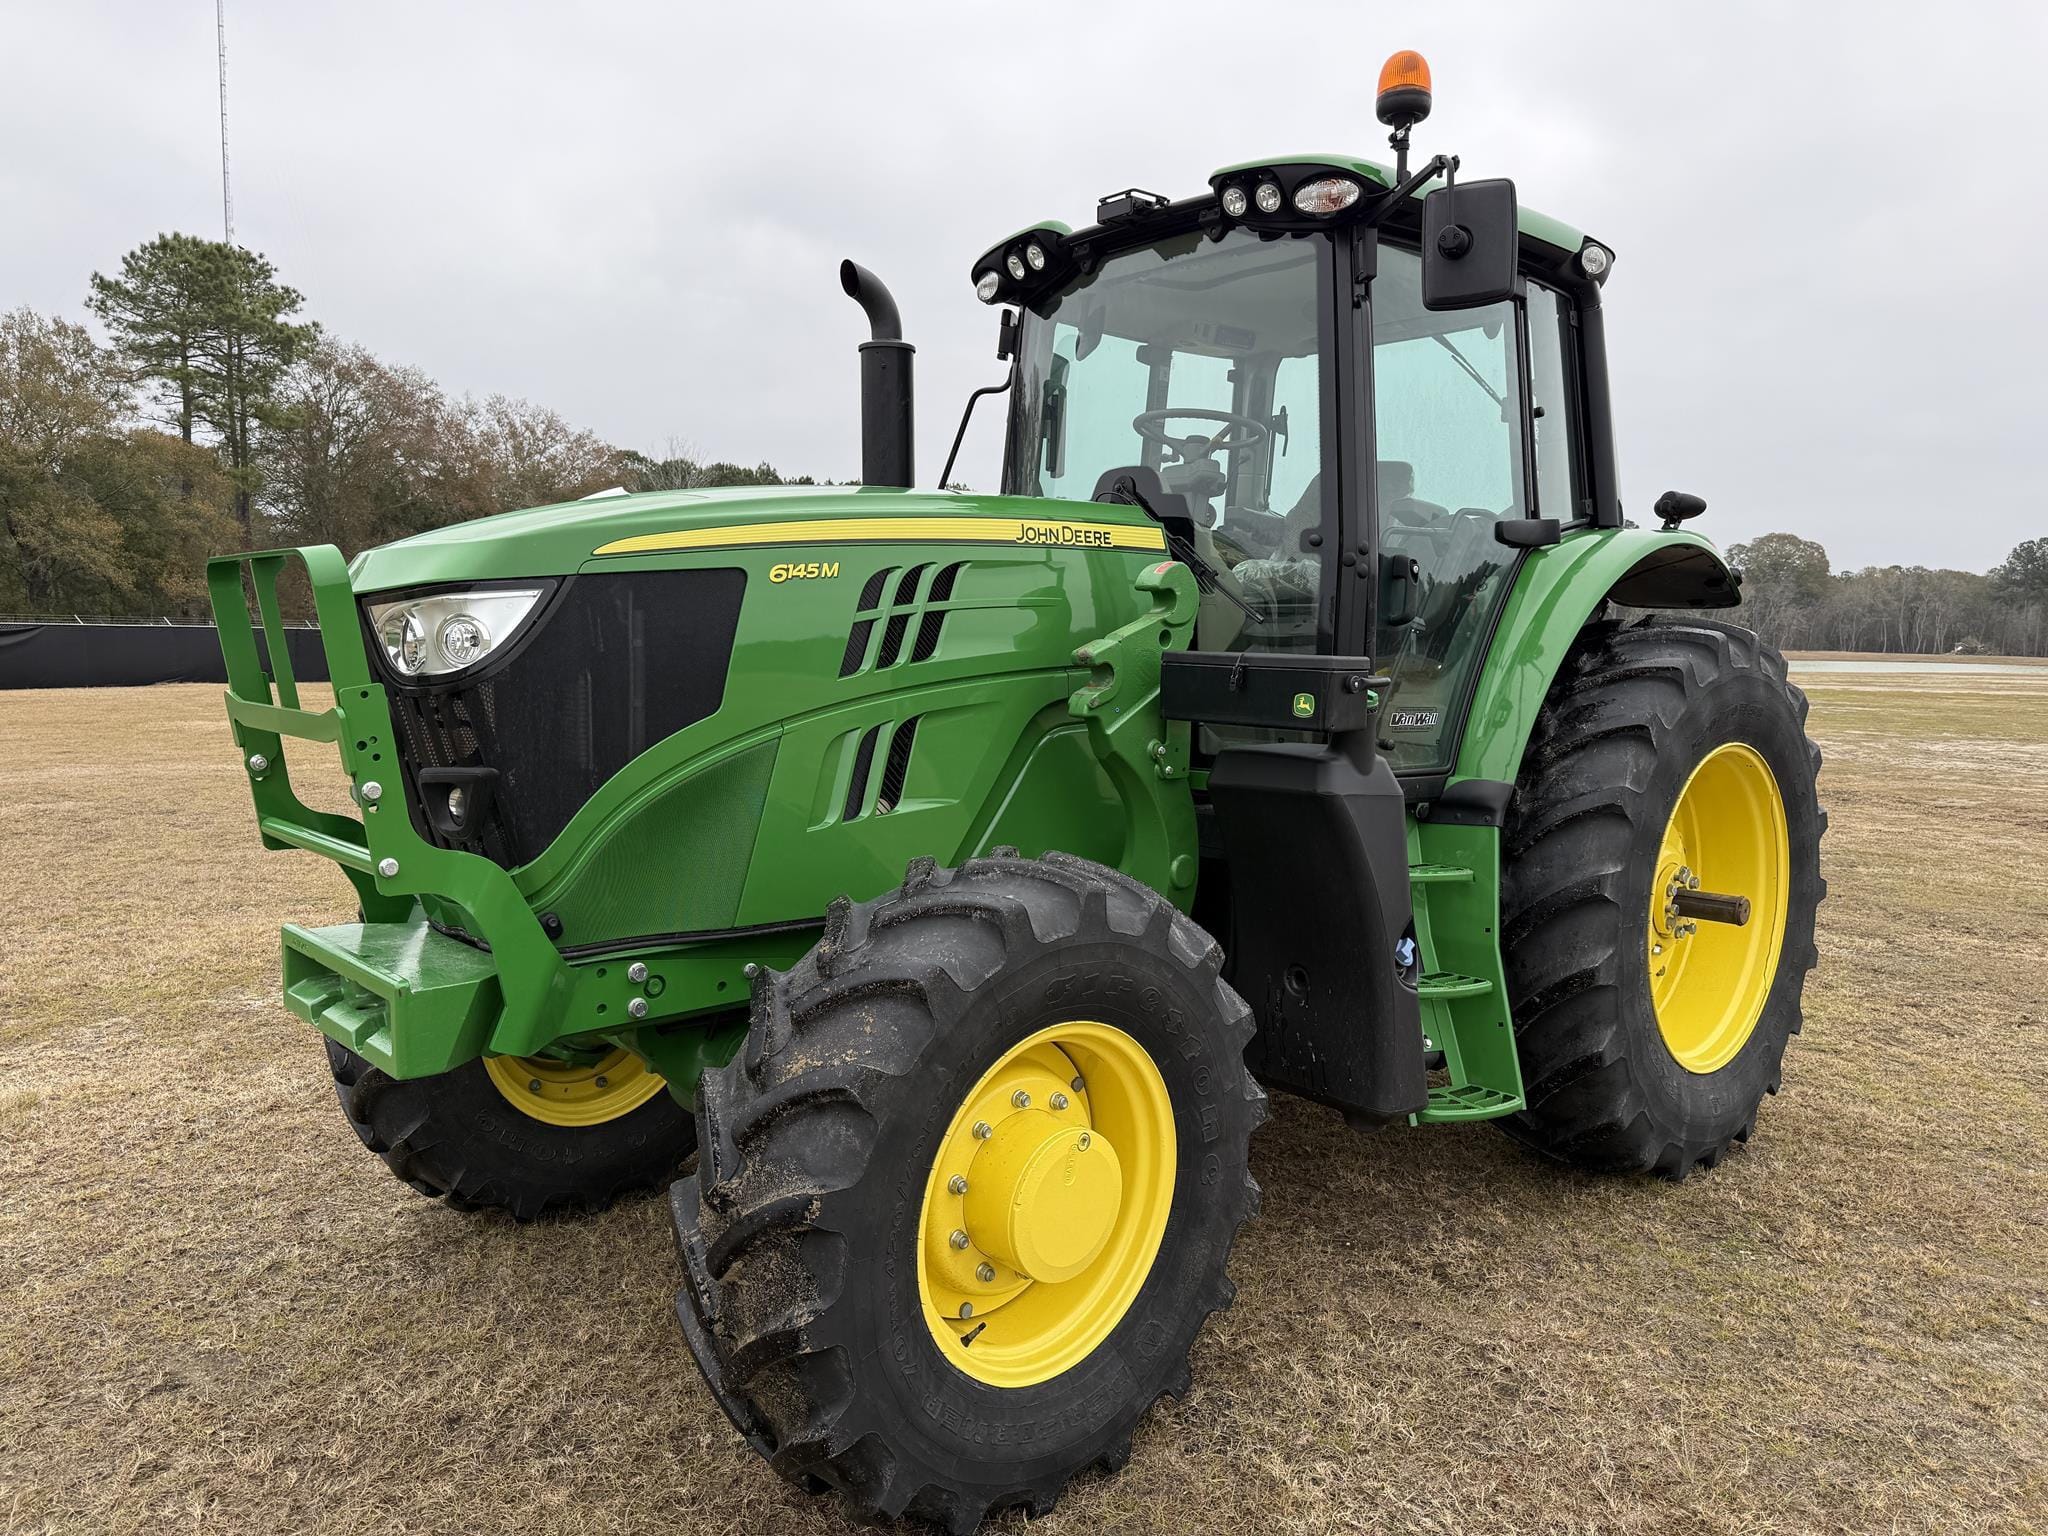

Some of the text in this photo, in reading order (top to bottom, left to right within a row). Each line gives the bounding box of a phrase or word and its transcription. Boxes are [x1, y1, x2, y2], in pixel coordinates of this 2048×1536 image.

[1016, 523, 1113, 545] JOHN DEERE
[769, 562, 839, 583] 6145M
